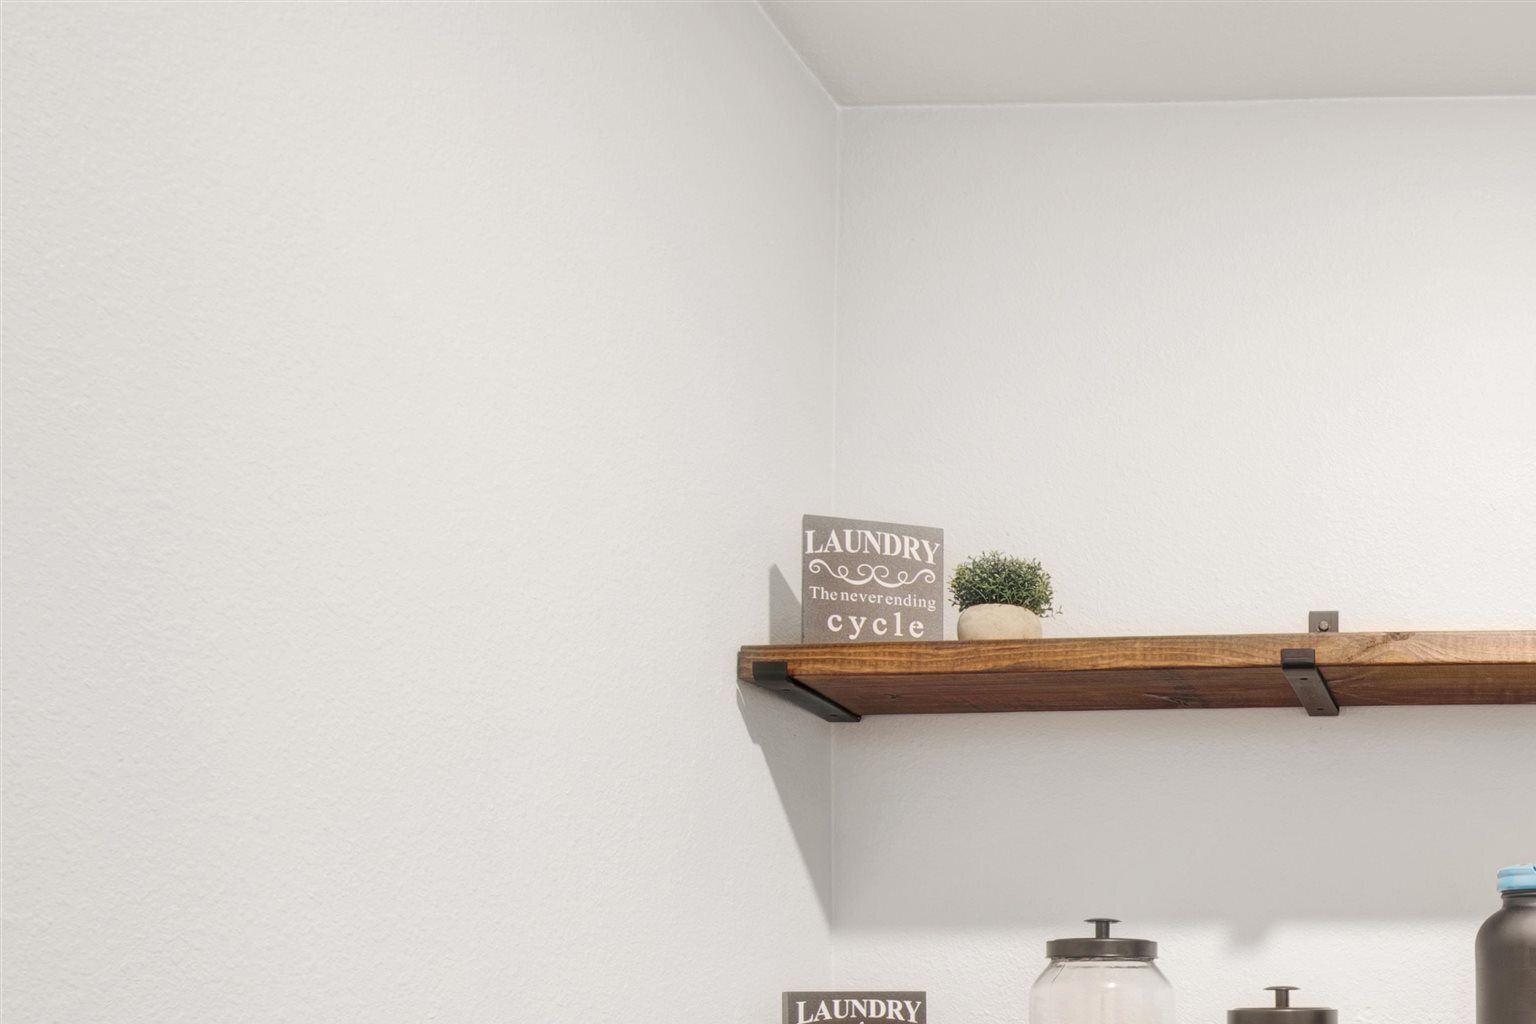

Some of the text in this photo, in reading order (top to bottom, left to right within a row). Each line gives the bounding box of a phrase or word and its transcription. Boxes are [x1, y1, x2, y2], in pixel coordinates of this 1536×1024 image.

[805, 530, 940, 564] LAUNDRY
[809, 586, 837, 601] The
[827, 612, 924, 640] cycle
[796, 999, 921, 1024] LAUNDRY
